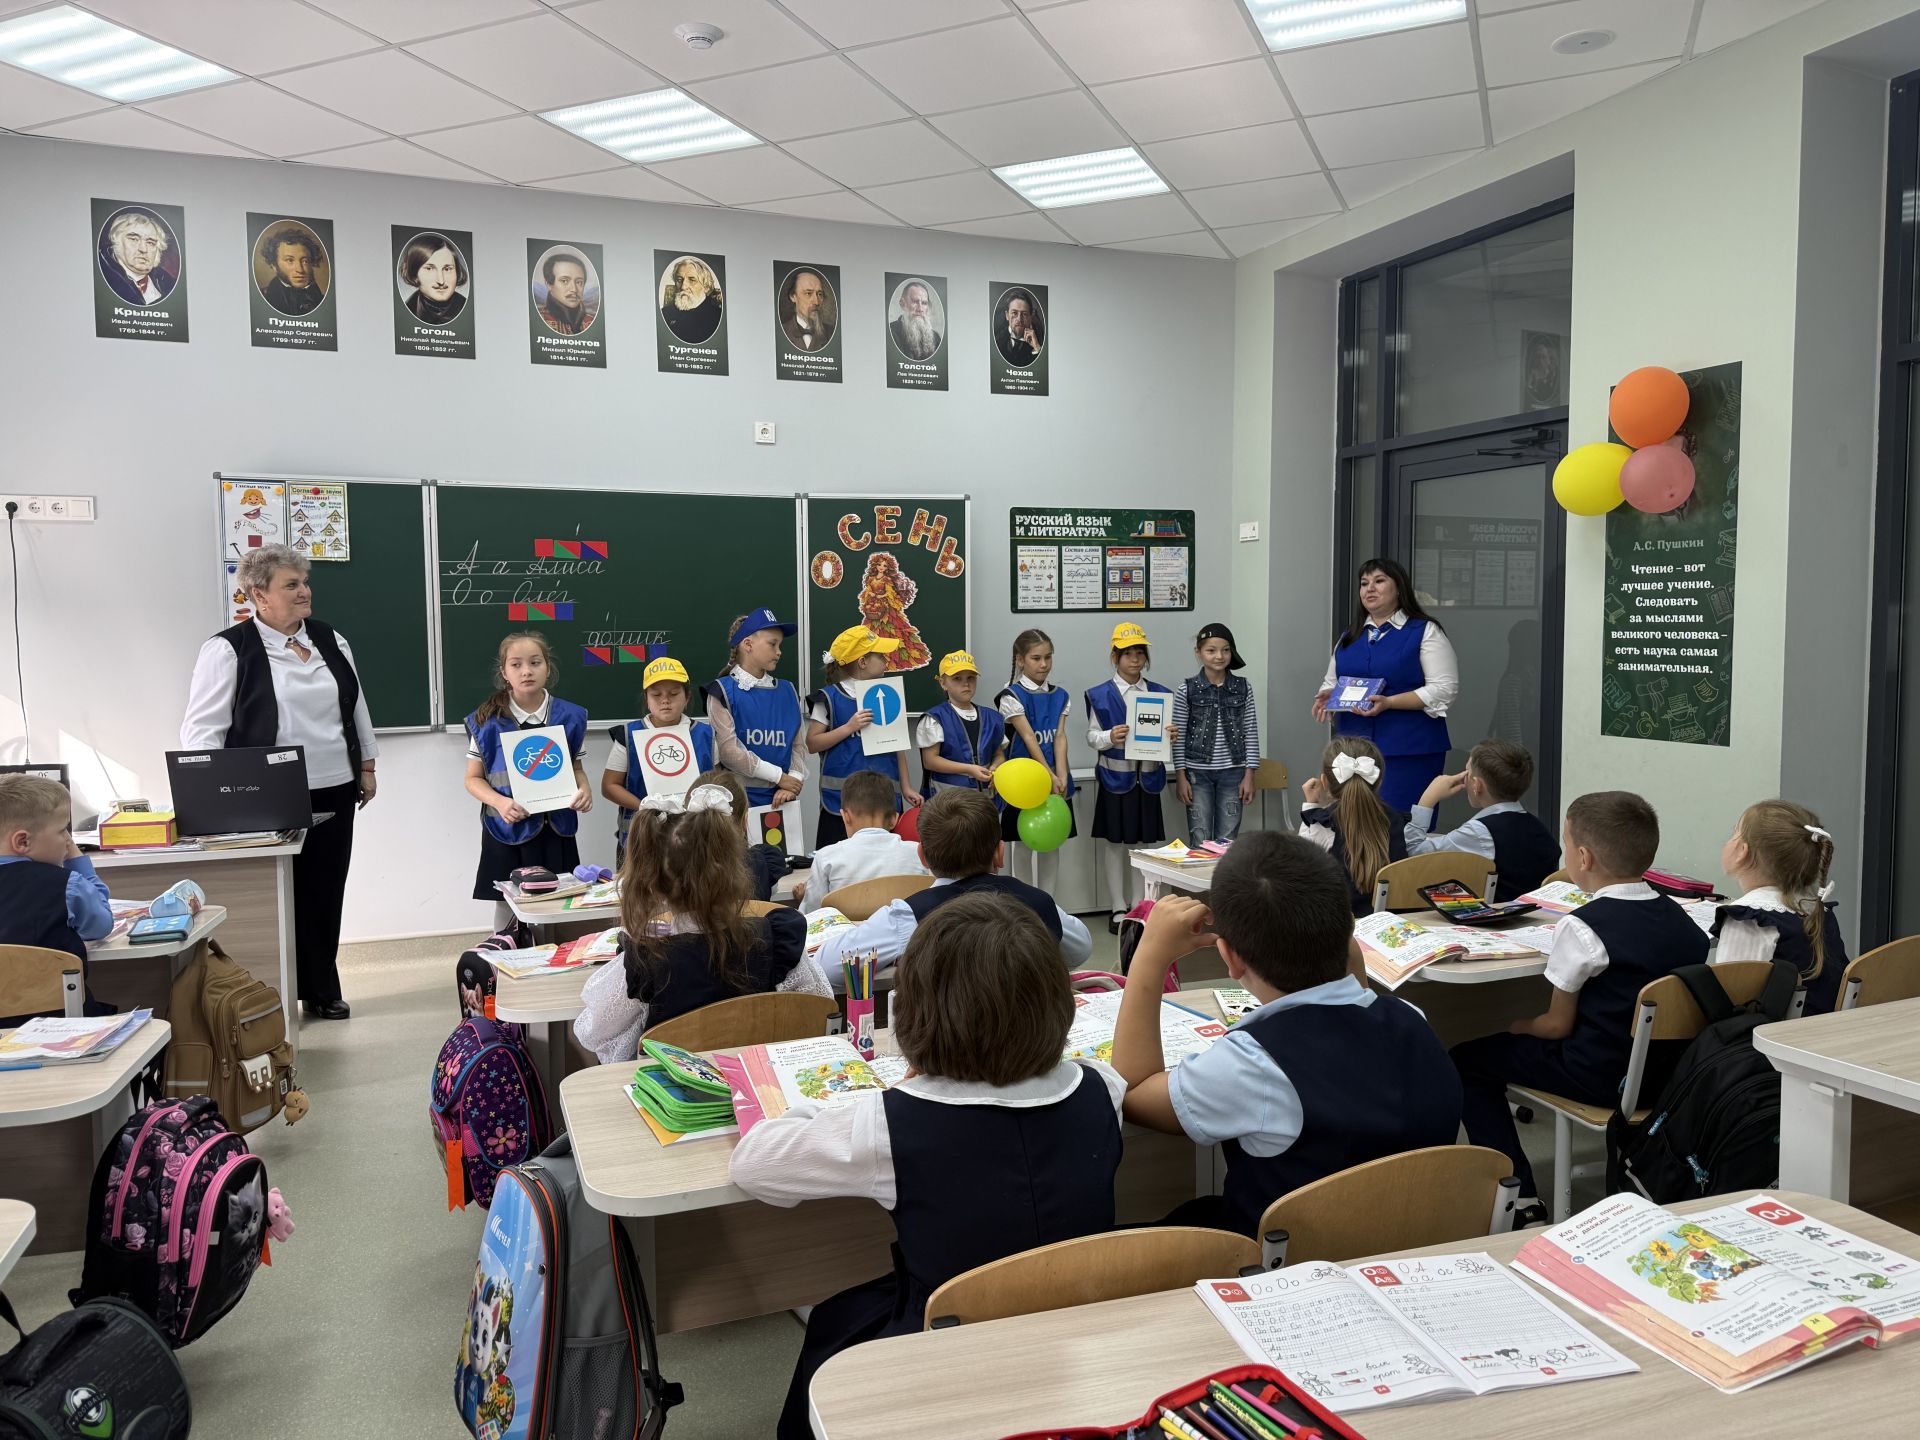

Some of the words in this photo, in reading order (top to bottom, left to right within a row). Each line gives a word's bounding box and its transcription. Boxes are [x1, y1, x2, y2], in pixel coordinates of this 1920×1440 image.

[114, 307, 170, 319] Крылов
[111, 318, 131, 326] Иван
[133, 320, 173, 328] Андреевич
[268, 317, 319, 328] Пушкин
[118, 327, 156, 335] 1769-1844
[255, 328, 294, 337] Александр
[295, 330, 334, 338] Сергеевич
[414, 327, 456, 337] Гоголь
[272, 336, 307, 345] 1799-1837
[431, 338, 470, 346] Васильевич
[537, 335, 601, 347] Лермонтов
[542, 346, 566, 354] Михаил
[567, 348, 596, 356] Юрьевич
[668, 345, 718, 357] Тургенев
[784, 353, 834, 364] Некрасов
[898, 361, 937, 371] Толстой
[1006, 369, 1034, 377] Чехов
[1015, 513, 1073, 526] РУССКИЙ
[1077, 516, 1112, 528] ЯЗЫК
[1015, 526, 1025, 536] И
[1028, 527, 1107, 538] ЛИТЕРАТУРА
[811, 505, 964, 588] ОСЕНЬ
[1633, 541, 1655, 551] А.С.
[1658, 539, 1704, 551] Пушкин
[525, 555, 606, 576] Алиса
[1631, 564, 1673, 574] Чтение
[1684, 563, 1706, 573] вот
[1621, 581, 1664, 593] лучшее
[1667, 580, 1715, 593] учение.
[1635, 596, 1698, 607] Следовать
[1629, 615, 1642, 623] за
[1646, 614, 1704, 623] мыслями
[1611, 630, 1661, 640] великого
[1664, 630, 1720, 640] человека
[1615, 646, 1640, 655] есть
[1643, 646, 1677, 658] наука
[1680, 647, 1718, 657] самая
[649, 662, 677, 677] ЮИД
[1618, 663, 1714, 674] занимательная.
[746, 729, 787, 747] ЮИД
[1759, 1208, 1791, 1220] Оо
[1558, 1229, 1574, 1239] Кто
[1575, 1215, 1598, 1231] скоро
[1581, 1216, 1610, 1237] дважды
